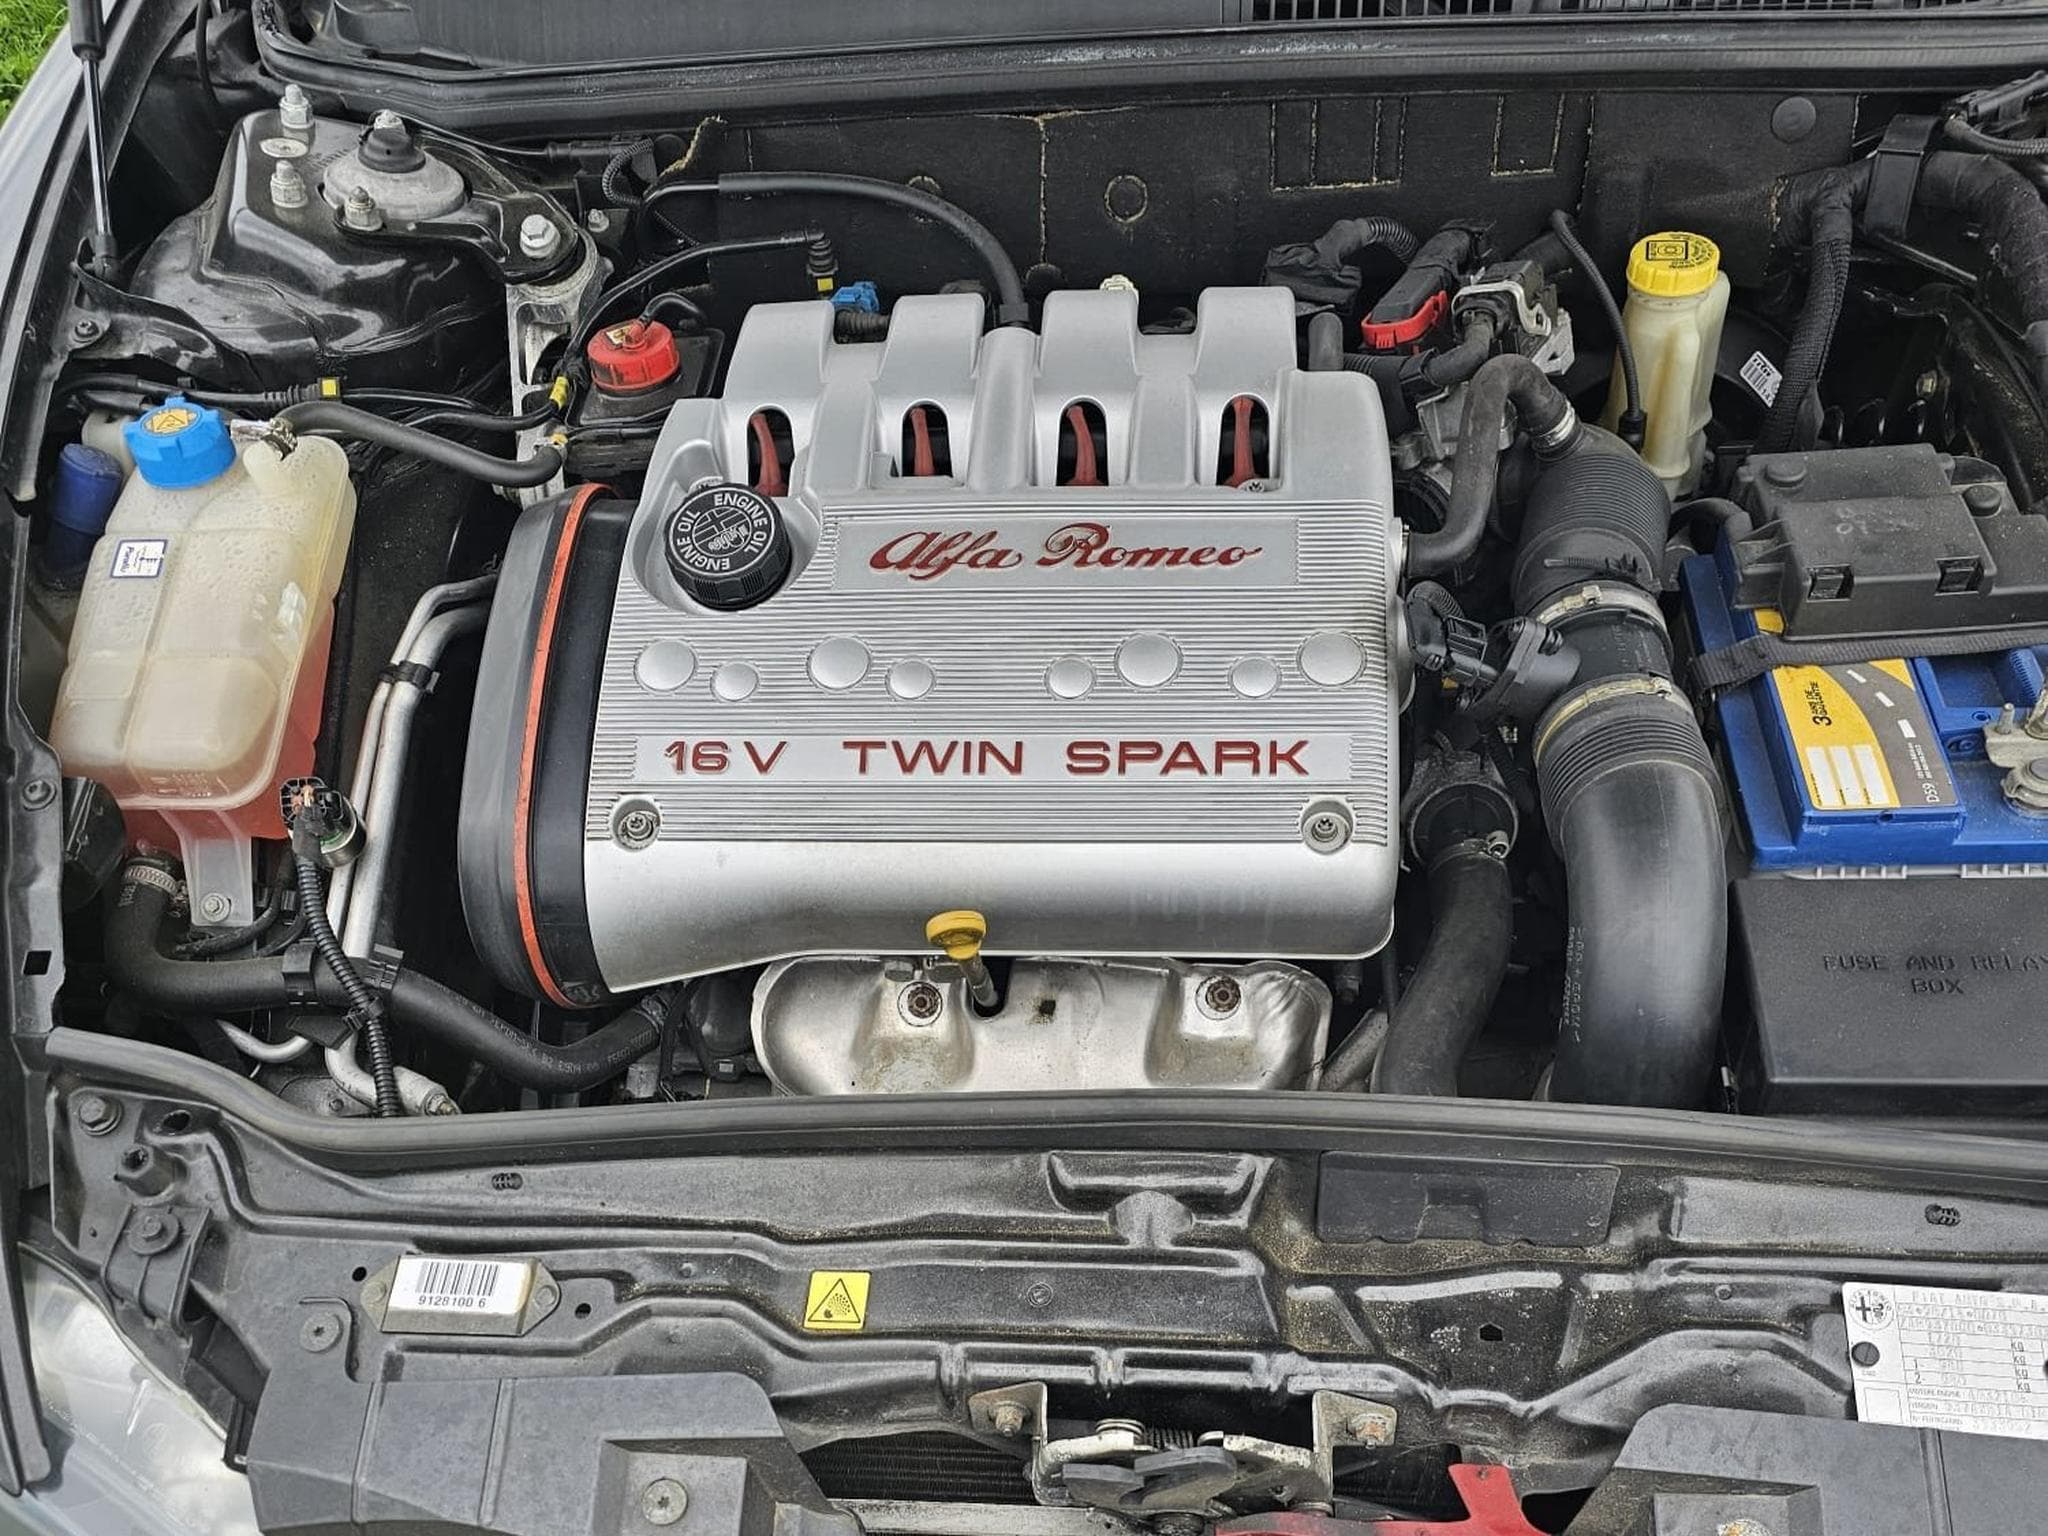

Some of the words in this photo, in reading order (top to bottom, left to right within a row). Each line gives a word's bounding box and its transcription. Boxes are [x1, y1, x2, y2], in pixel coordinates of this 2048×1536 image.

[677, 510, 701, 532] OIL
[714, 493, 768, 528] ENGINE
[744, 531, 767, 553] OIL
[677, 536, 730, 571] ENGINE
[869, 530, 1023, 581] Alfa
[1036, 522, 1263, 568] Romeo
[842, 741, 1023, 776] TWIN
[1065, 741, 1310, 776] SPARK
[1823, 955, 1889, 971] FUSE
[1905, 955, 1956, 971] AND
[1911, 977, 1964, 994] BOX
[418, 1294, 473, 1307] 9128100
[478, 1297, 486, 1308] 6
